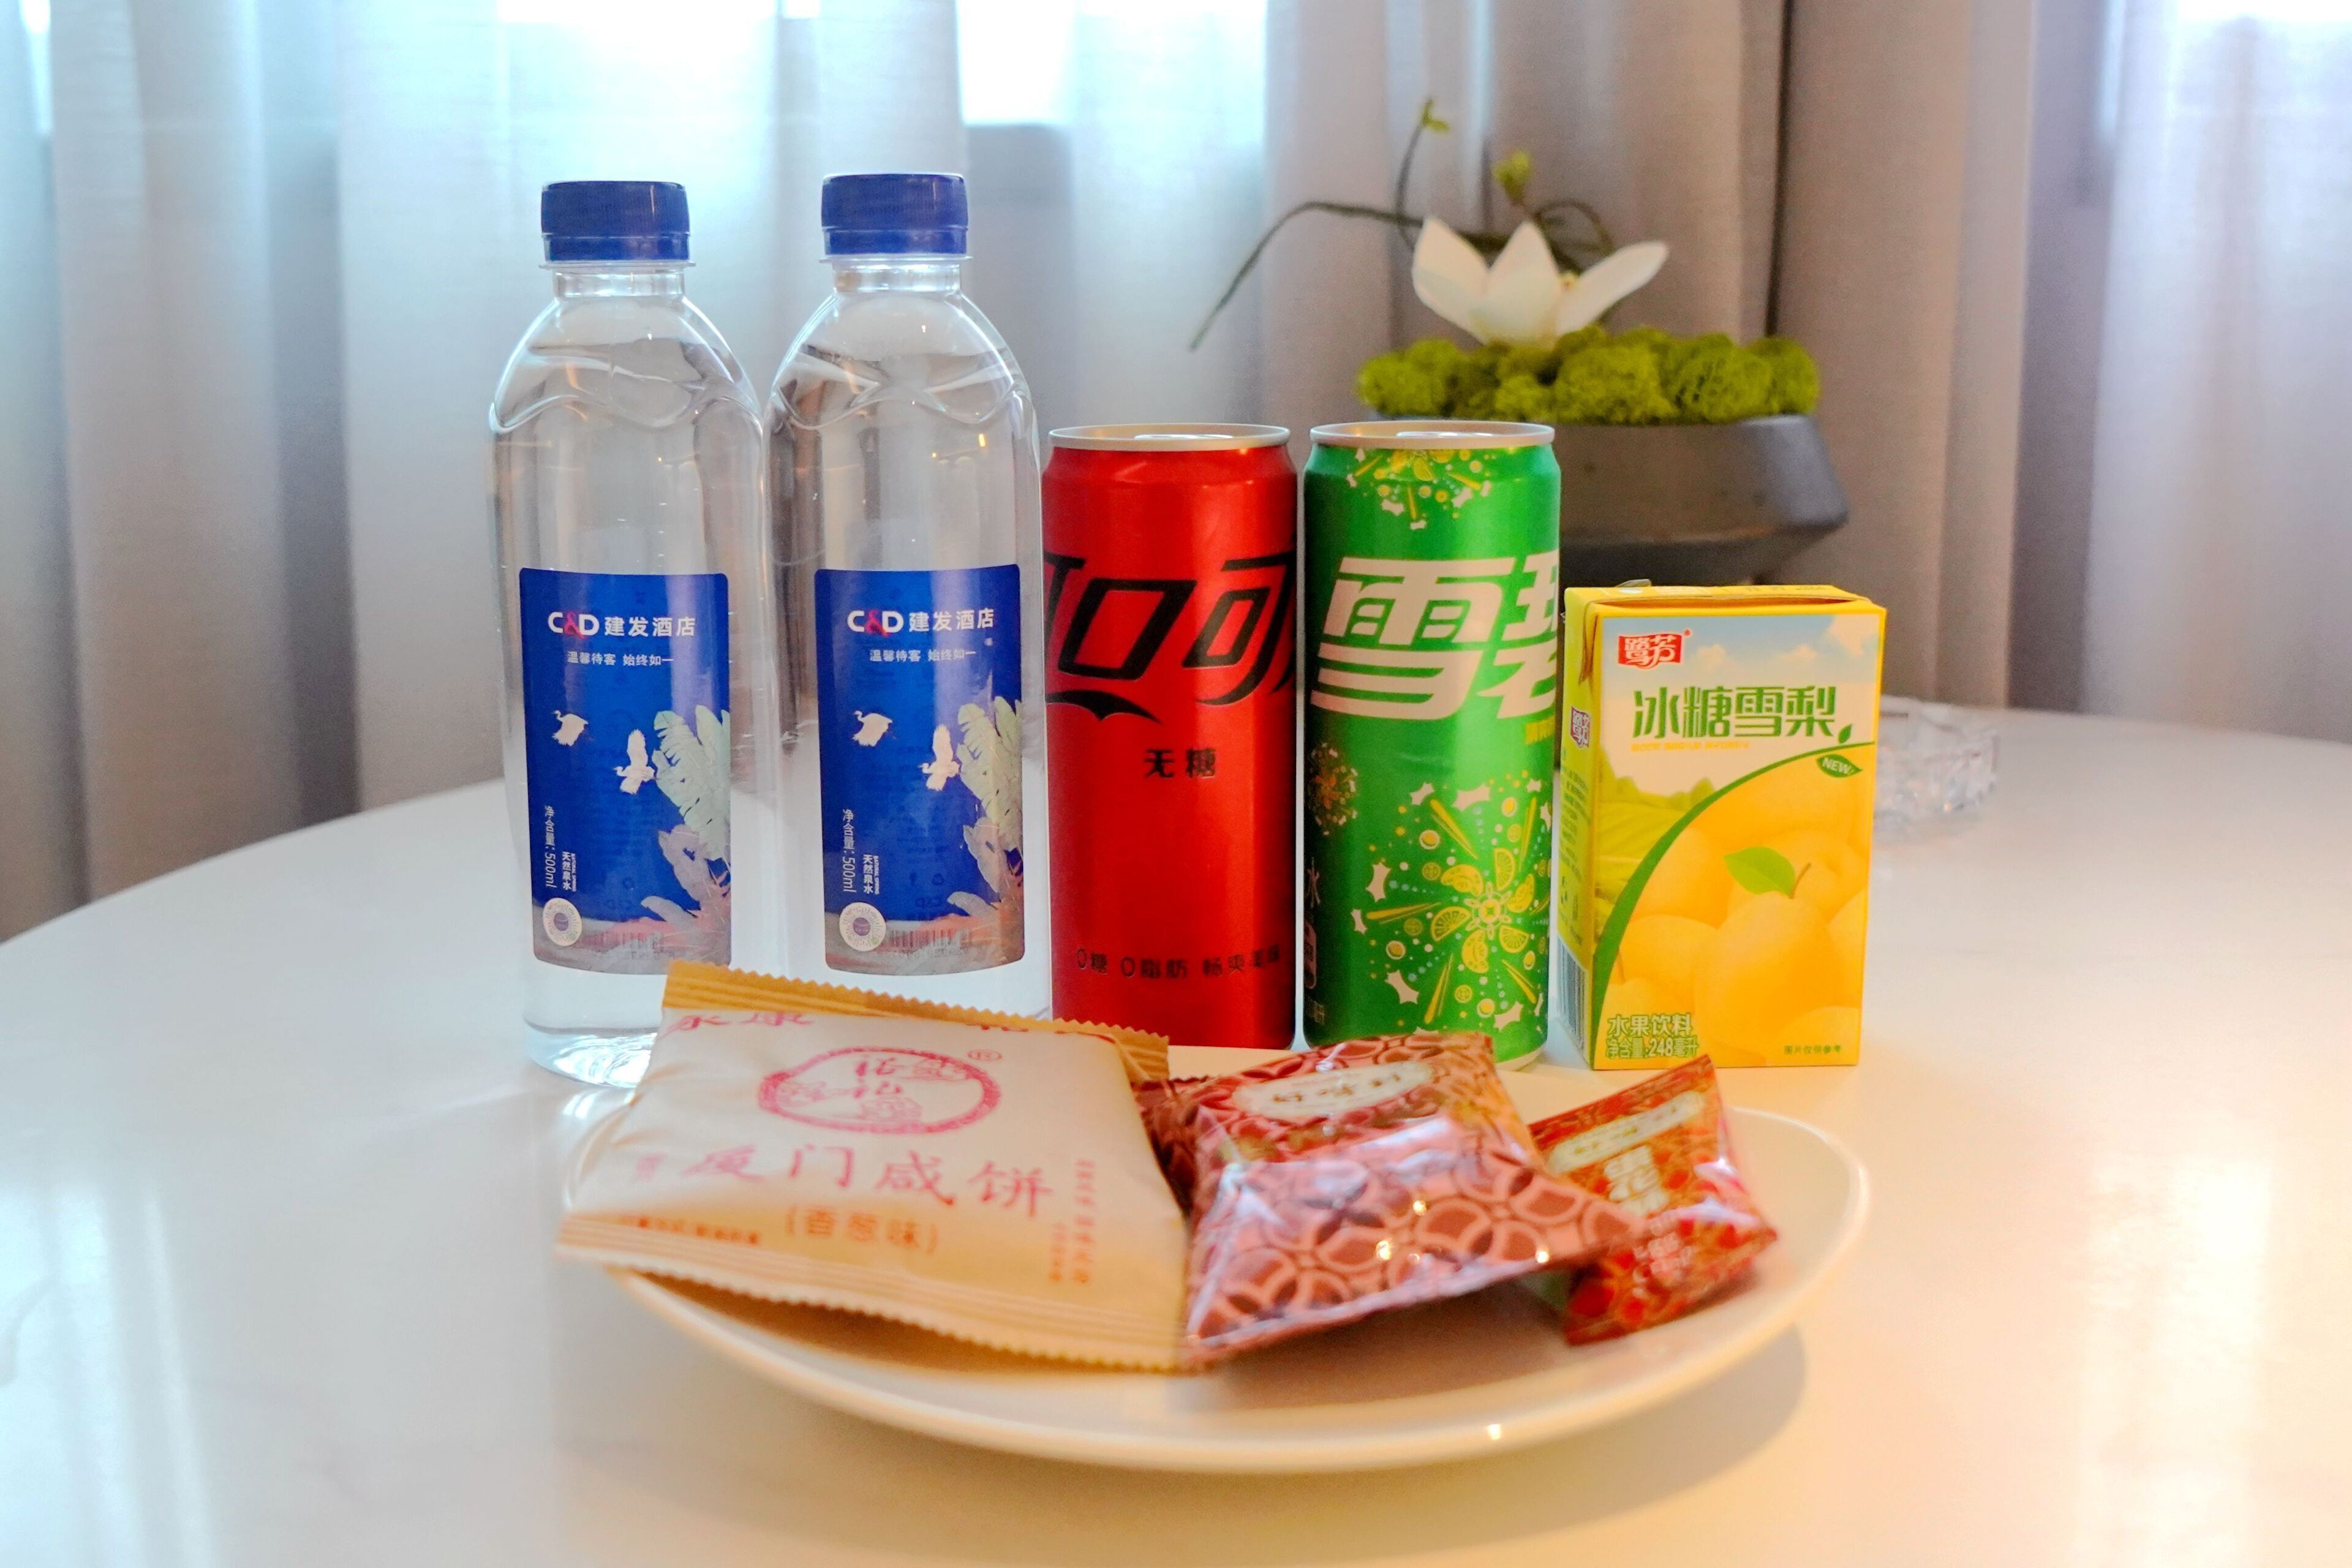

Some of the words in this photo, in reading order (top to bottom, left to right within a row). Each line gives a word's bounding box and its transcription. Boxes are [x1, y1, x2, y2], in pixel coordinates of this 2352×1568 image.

[548, 611, 600, 639] C&D
[604, 616, 696, 637] 建发酒店
[847, 610, 904, 637] C&D
[909, 608, 994, 633] 建发酒店
[567, 650, 616, 666] 温馨待客
[622, 653, 674, 666] 始终如一
[870, 649, 921, 662] 温馨待客
[928, 649, 976, 662] 始终如一
[1633, 686, 1836, 739] 冰糖雪梨
[1144, 748, 1216, 779] 无糖
[1608, 1013, 1692, 1037] 水果饮料
